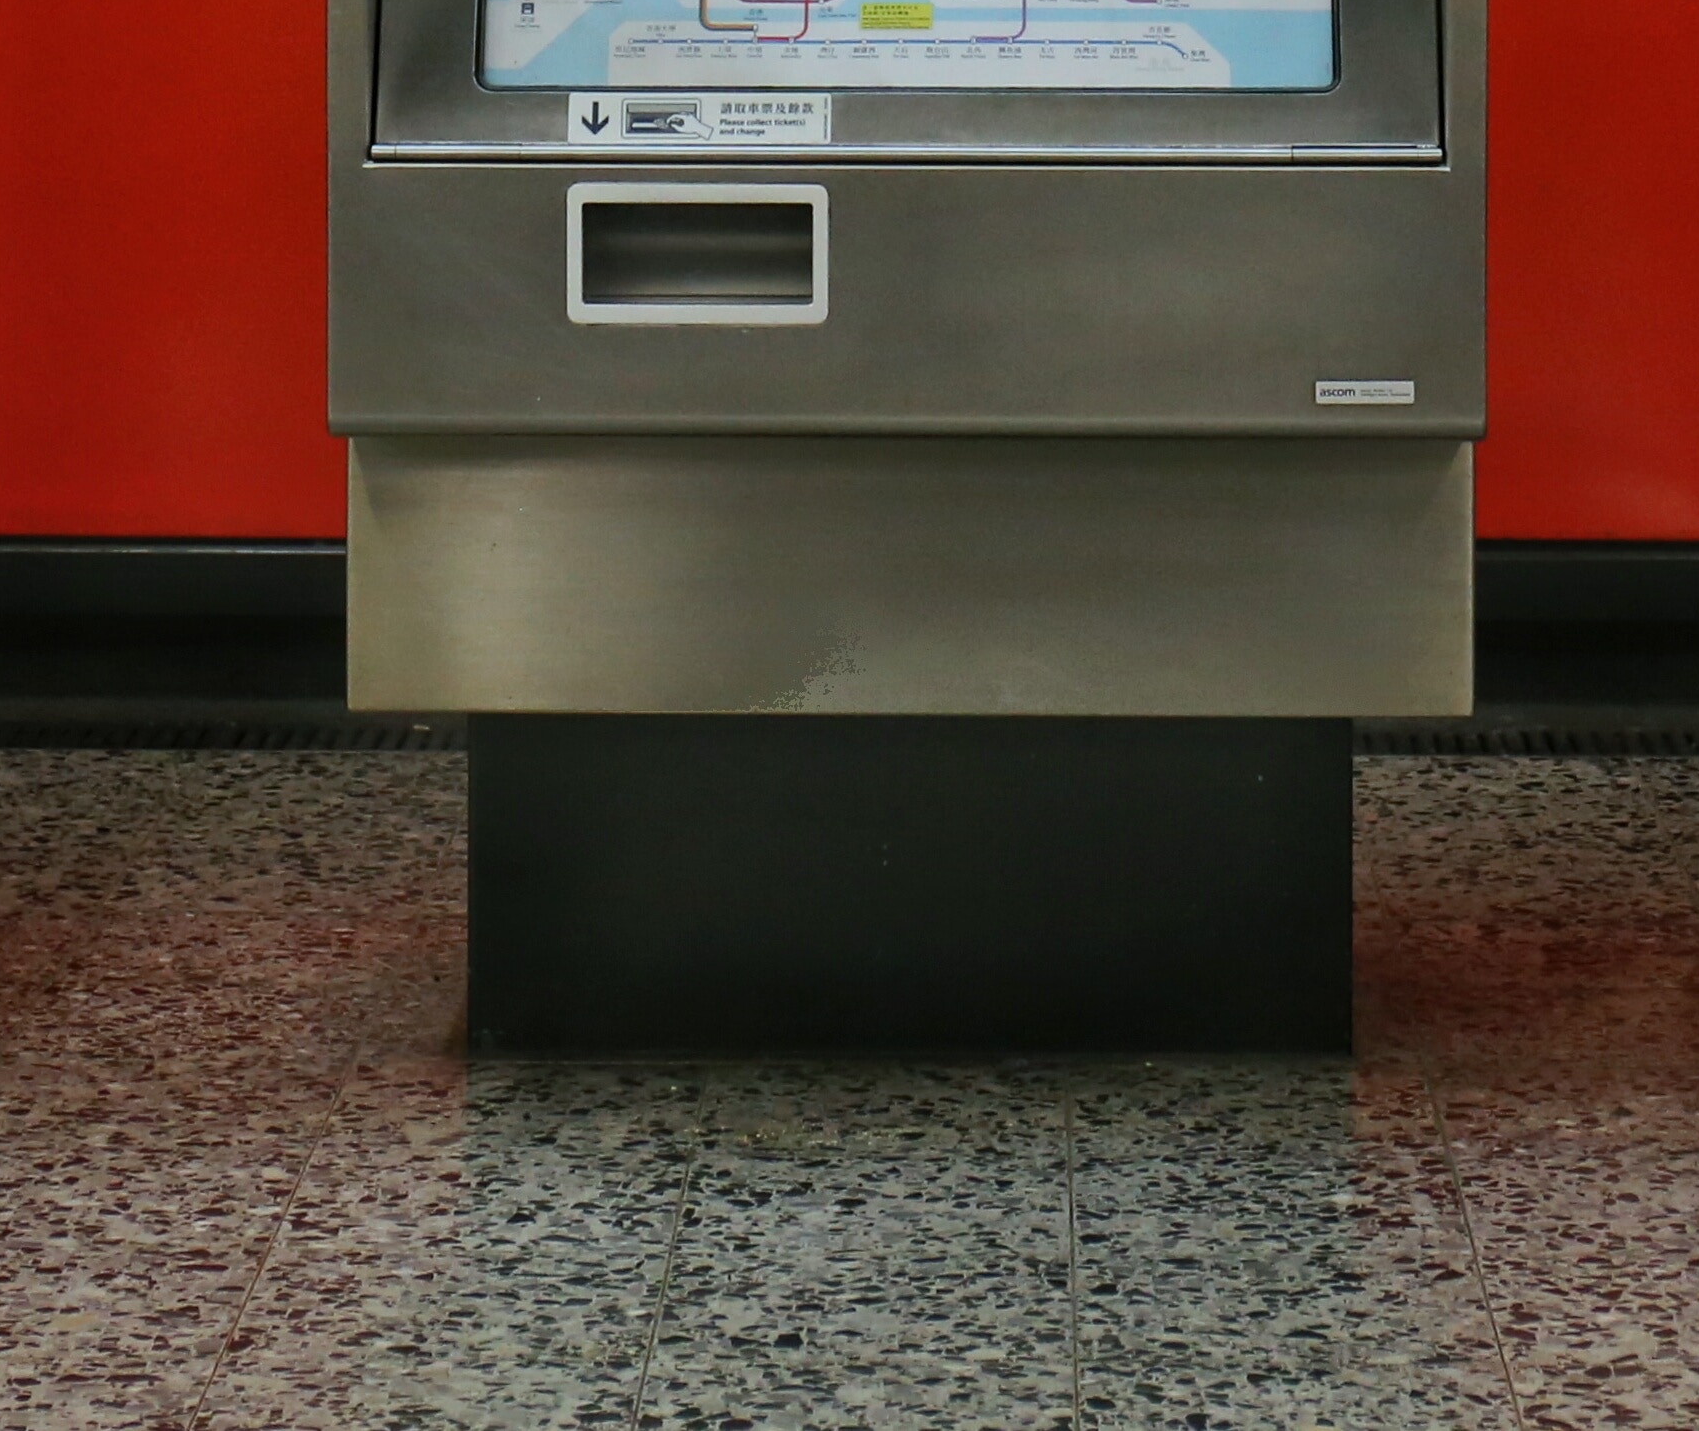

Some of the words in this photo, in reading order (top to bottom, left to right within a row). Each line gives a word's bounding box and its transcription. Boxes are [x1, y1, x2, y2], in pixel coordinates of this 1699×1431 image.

[720, 102, 815, 116] 請取車票及餘款
[719, 119, 745, 127] Please
[746, 119, 773, 127] collect
[774, 118, 806, 127] ticket(s)
[719, 128, 734, 136] and
[736, 128, 766, 137] change
[1319, 387, 1356, 398] ascom
